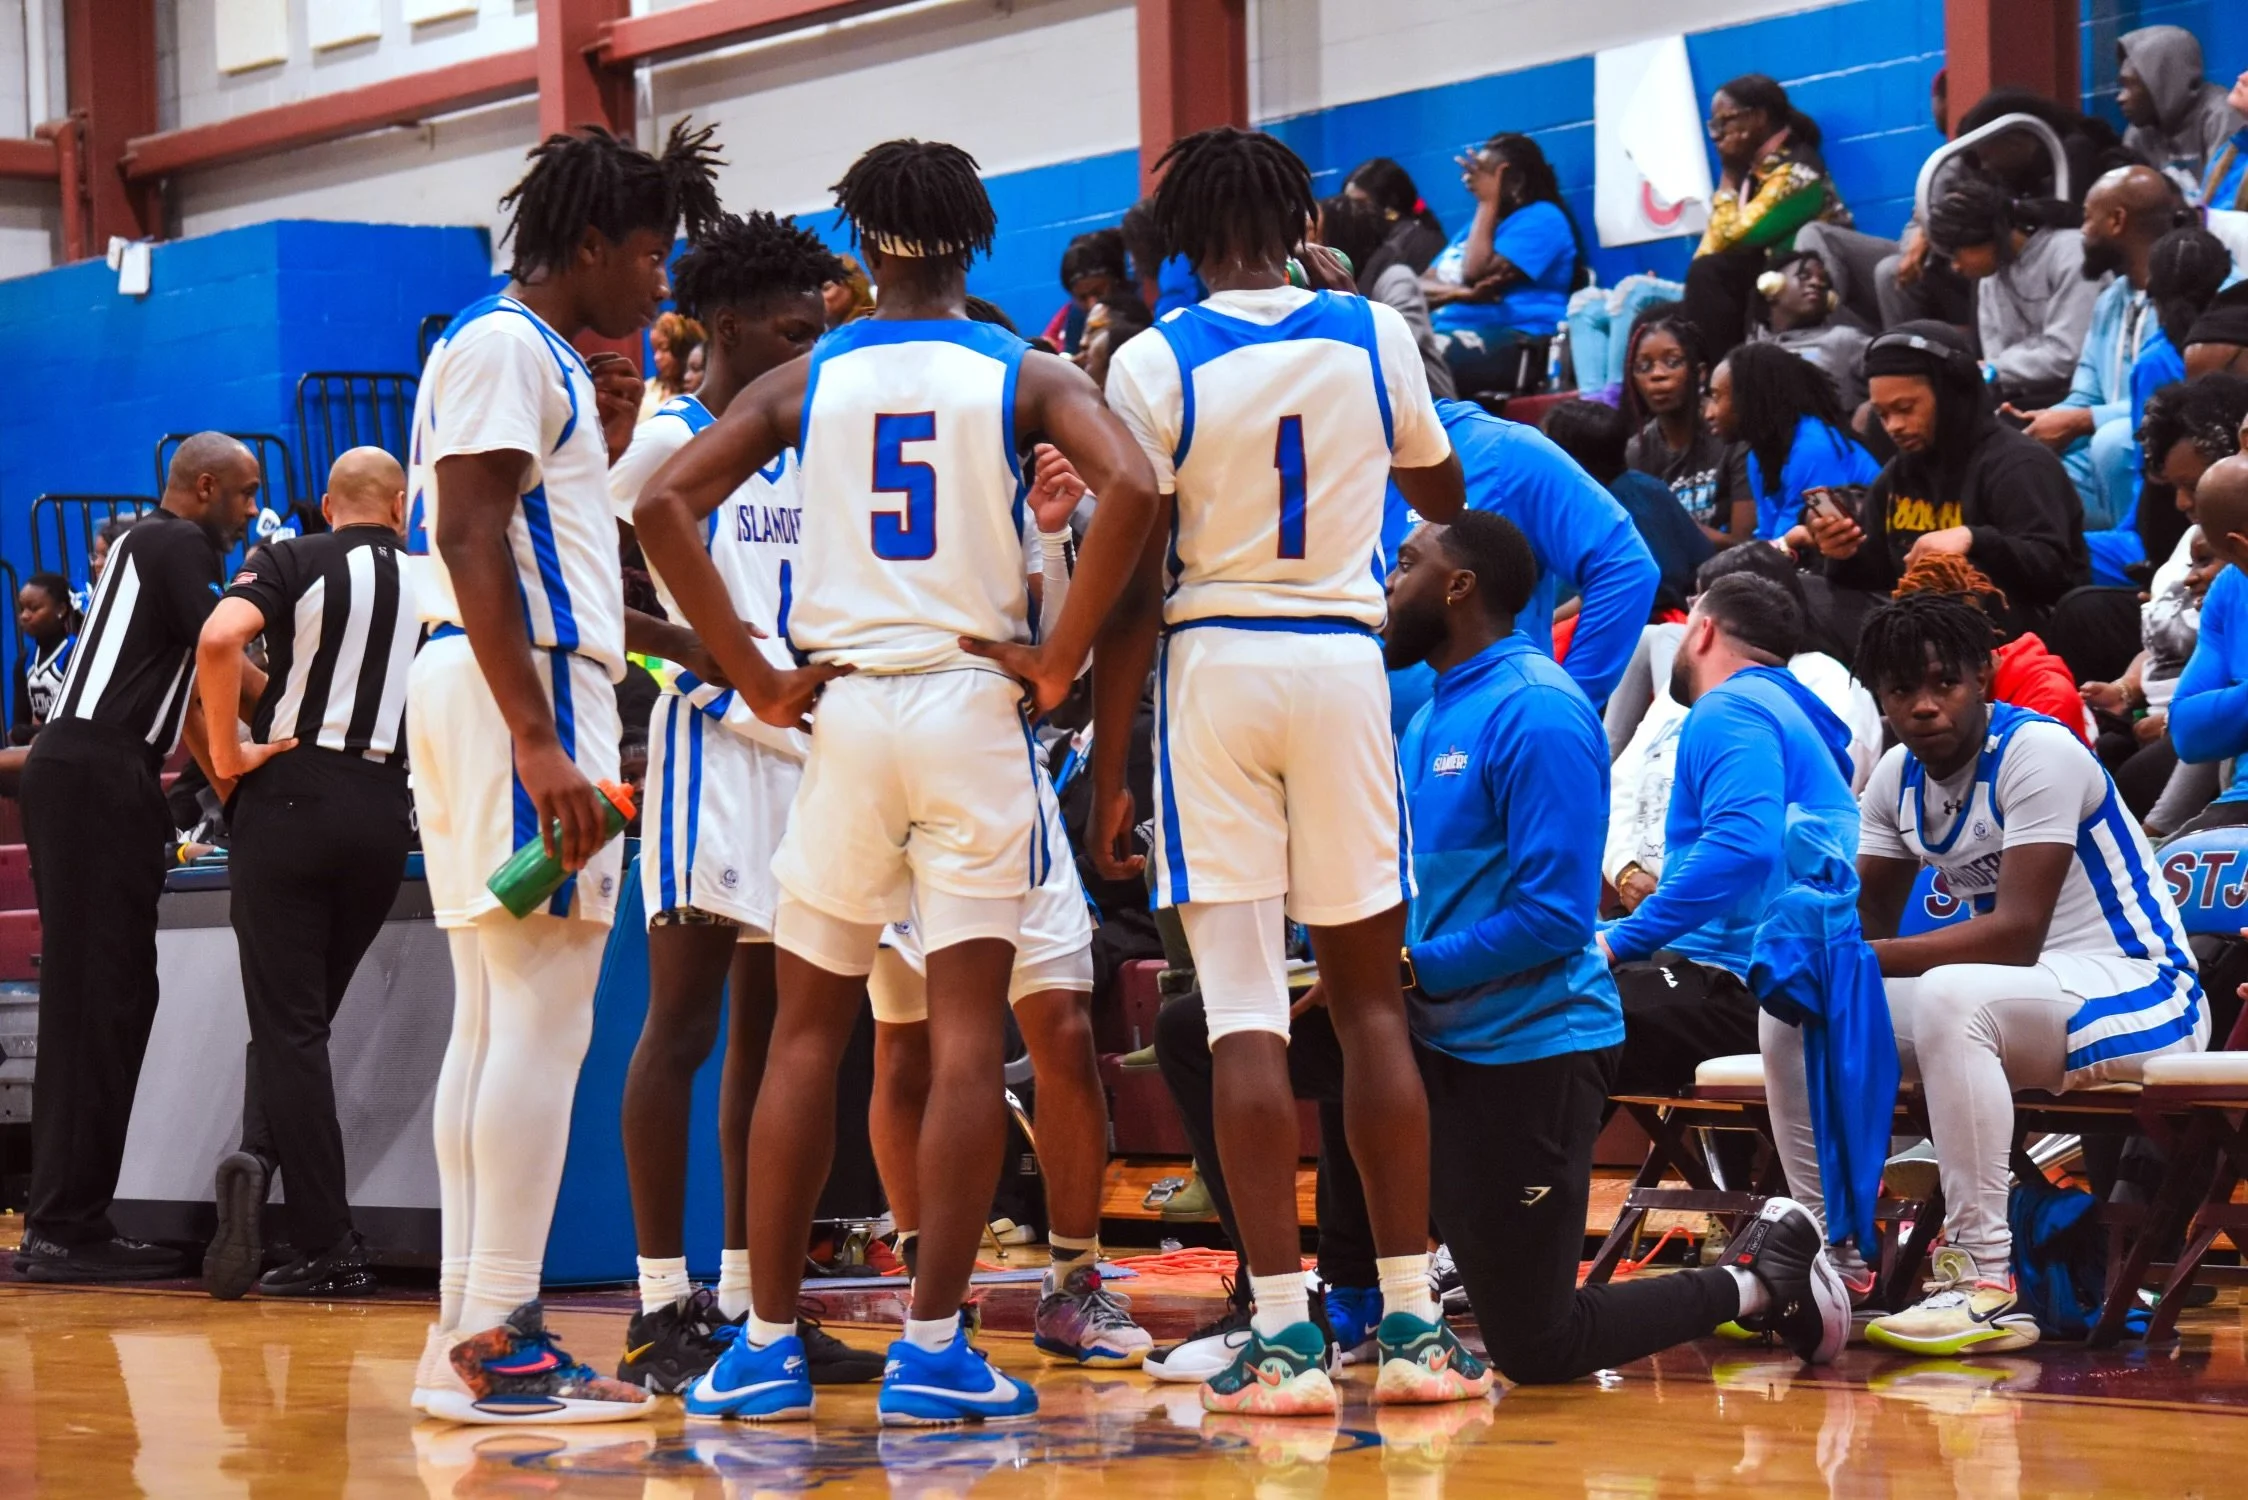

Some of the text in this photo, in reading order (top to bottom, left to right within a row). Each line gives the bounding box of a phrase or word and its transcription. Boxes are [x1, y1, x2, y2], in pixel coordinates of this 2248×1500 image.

[871, 411, 937, 561] 5
[1274, 414, 1307, 560] 1
[1659, 966, 1680, 989] FILA
